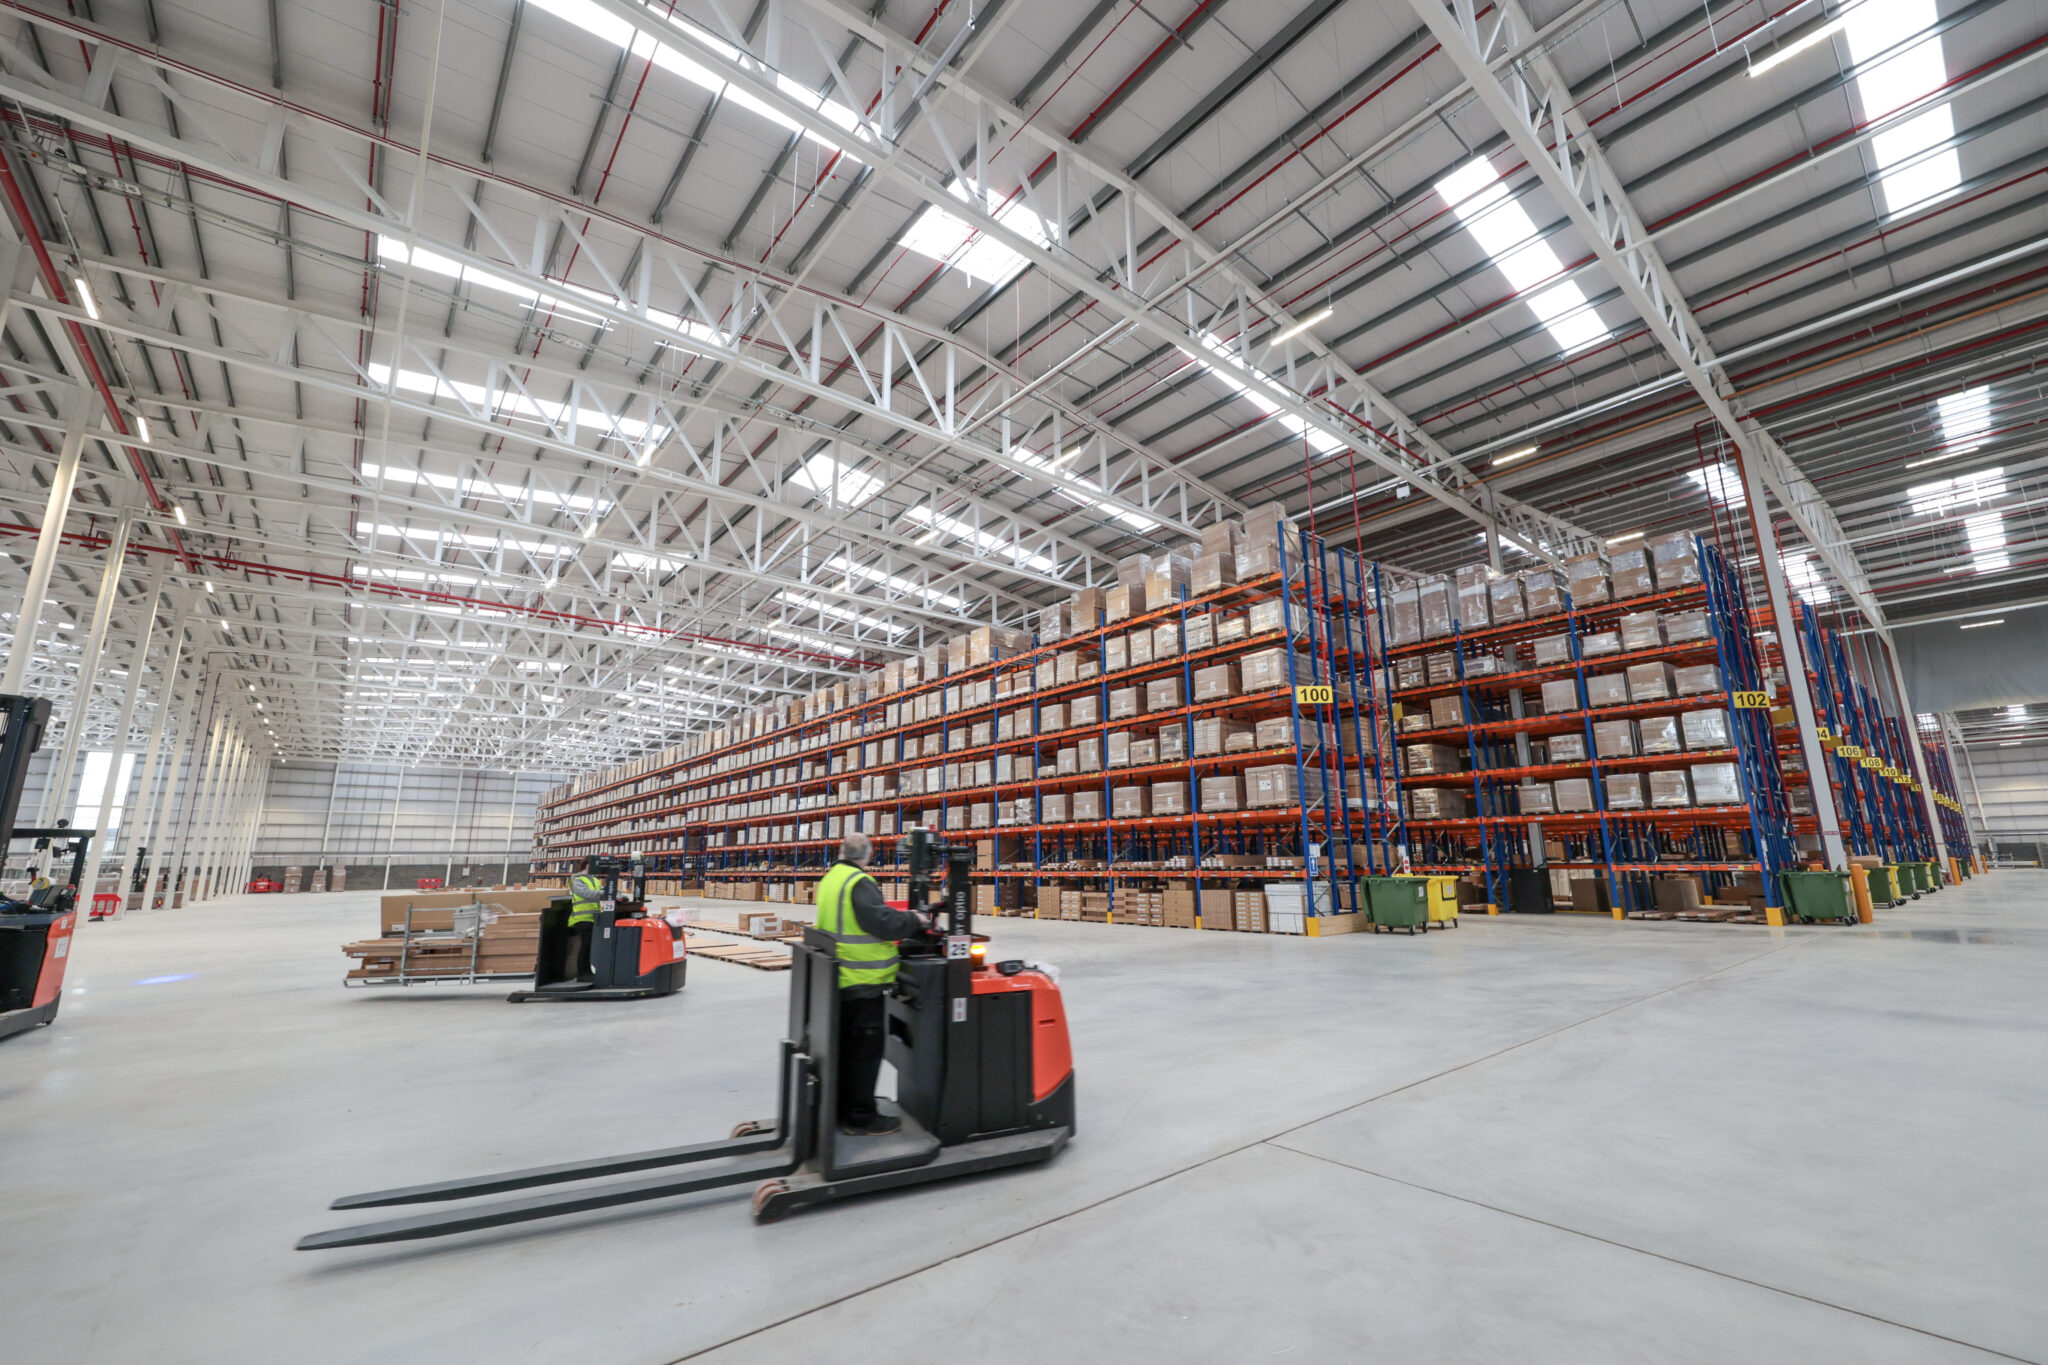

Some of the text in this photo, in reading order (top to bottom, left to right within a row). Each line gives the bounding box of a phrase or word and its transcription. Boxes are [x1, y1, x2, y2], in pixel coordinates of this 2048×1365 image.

[1300, 688, 1330, 702] 100
[1737, 693, 1767, 706] 102
[1839, 747, 1860, 756] 106
[1862, 759, 1881, 767] 108
